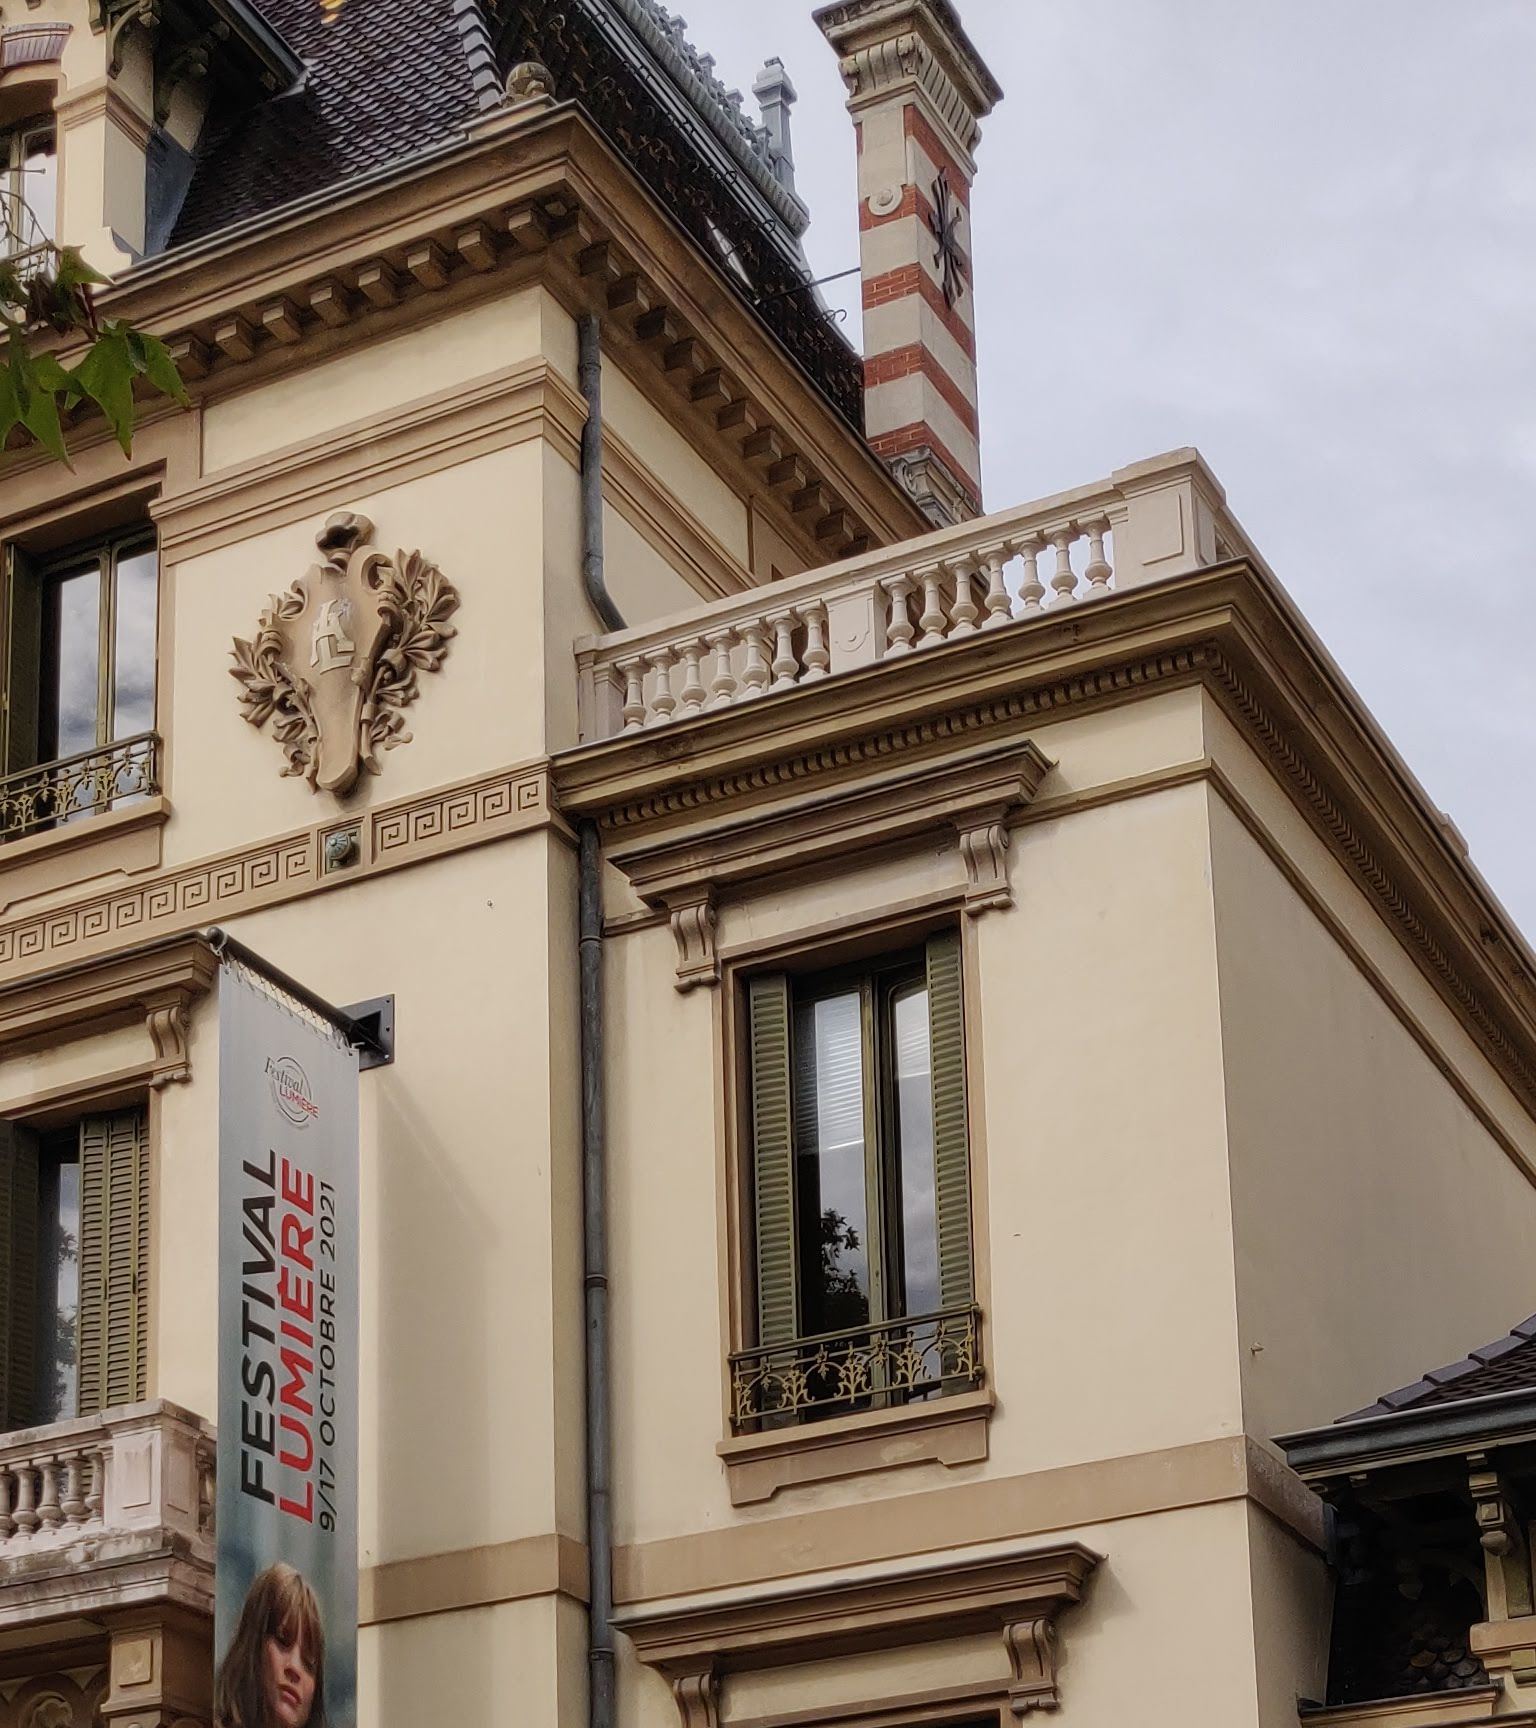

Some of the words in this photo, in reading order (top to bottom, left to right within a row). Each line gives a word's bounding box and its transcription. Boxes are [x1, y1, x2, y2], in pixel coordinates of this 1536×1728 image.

[265, 1056, 303, 1094] Festival
[319, 1182, 336, 1263] 2021
[240, 1149, 277, 1505] FESTIVAL
[277, 1157, 315, 1524] LUMIÈRE
[319, 1270, 336, 1446] OCTOBRE
[318, 1463, 336, 1533] 9/17
